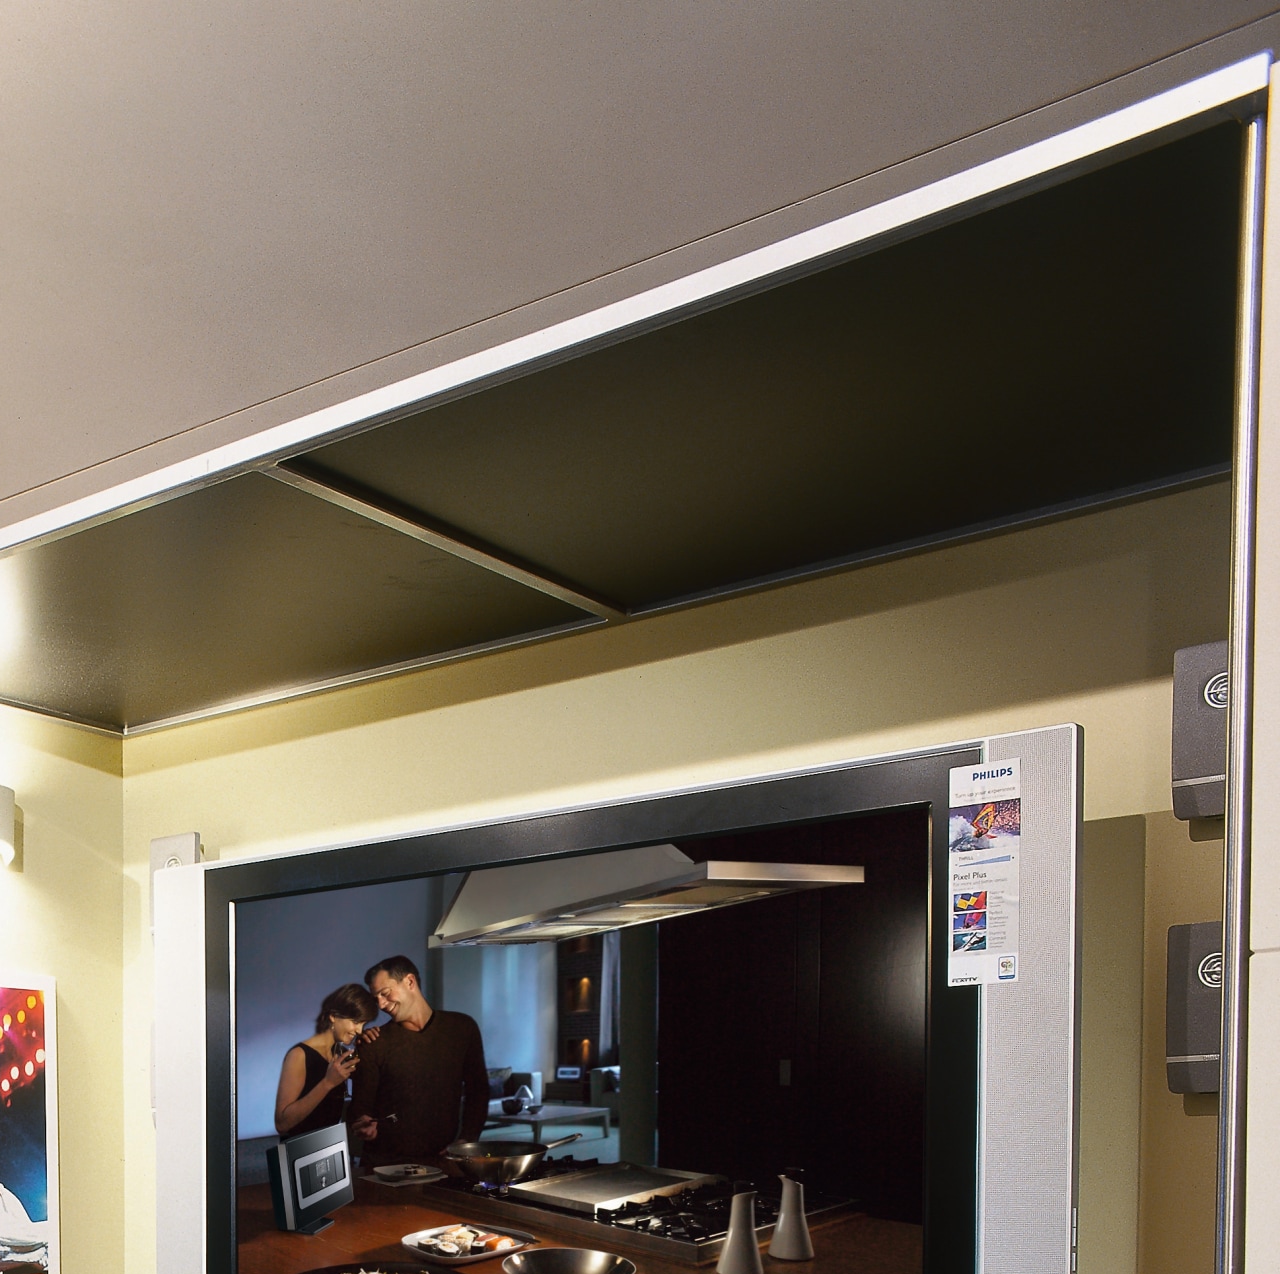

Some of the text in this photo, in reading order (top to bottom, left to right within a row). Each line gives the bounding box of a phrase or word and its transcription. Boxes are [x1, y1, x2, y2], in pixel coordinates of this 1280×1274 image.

[972, 767, 1013, 781] PHILIPS
[953, 871, 987, 881] Pixel Plus
